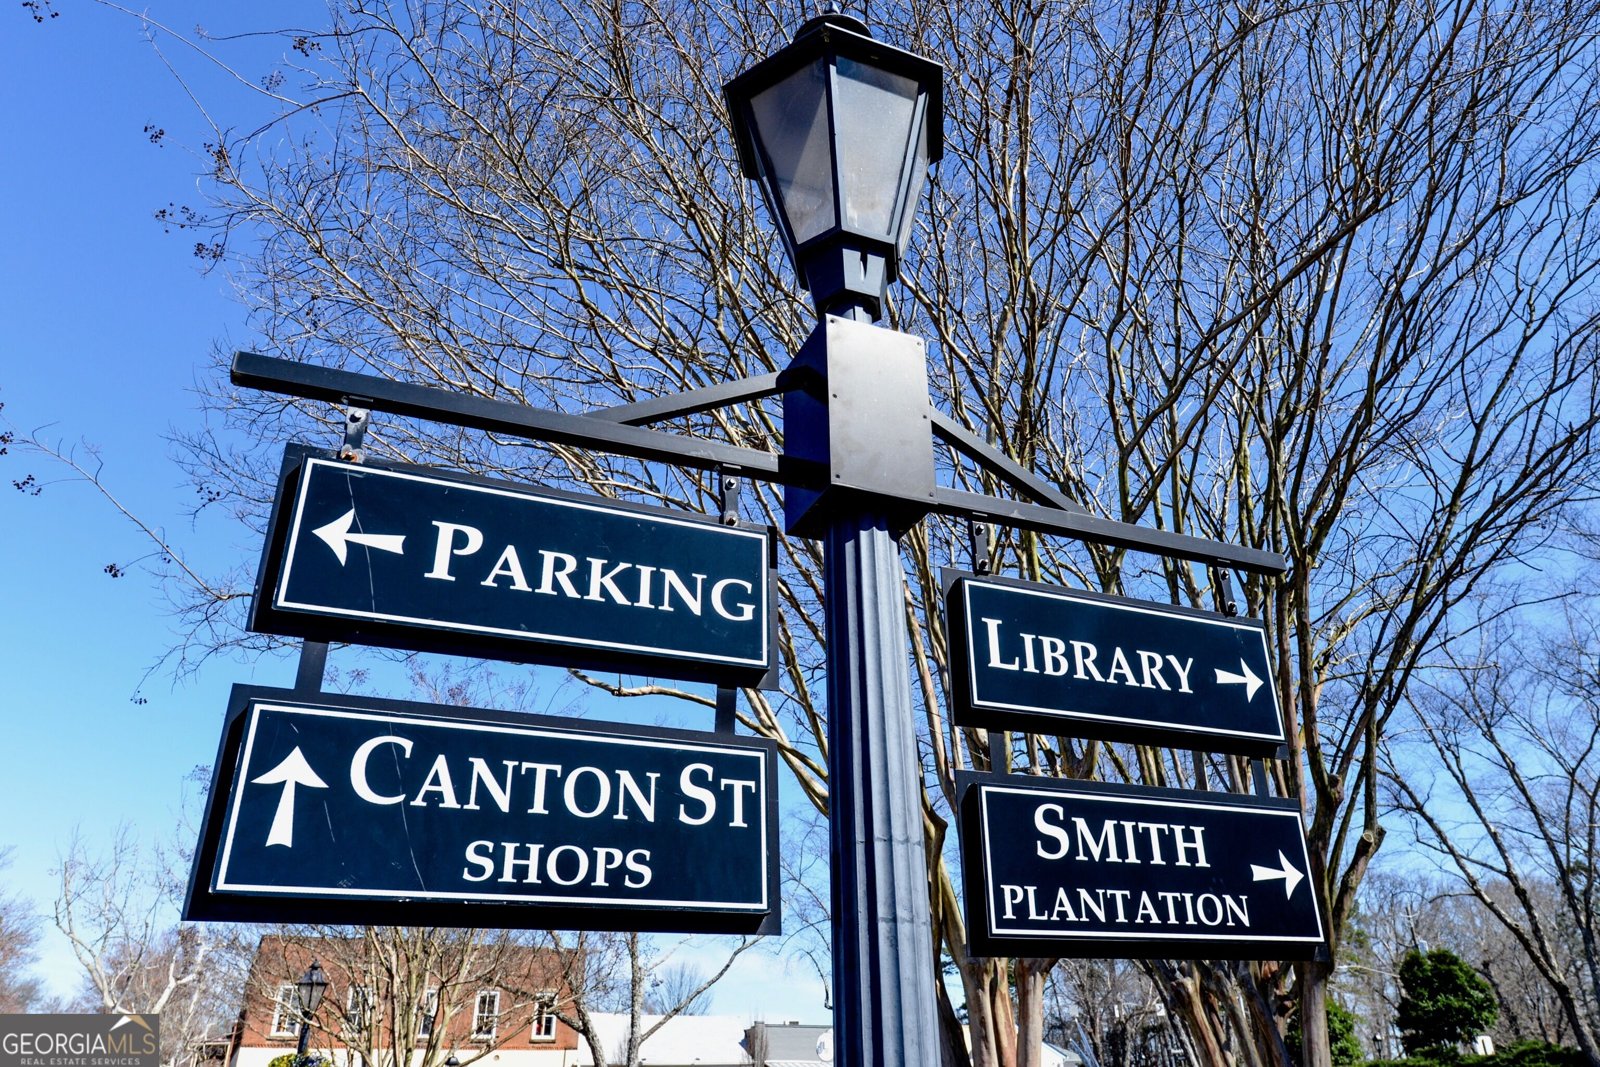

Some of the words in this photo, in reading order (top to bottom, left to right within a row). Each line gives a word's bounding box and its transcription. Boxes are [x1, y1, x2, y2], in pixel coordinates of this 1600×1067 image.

[424, 520, 756, 622] PARKING
[981, 617, 1194, 694] LIBRARY
[350, 735, 661, 823] CANTON
[678, 762, 757, 828] ST
[462, 840, 652, 889] SHOPS
[1034, 803, 1211, 868] SMITH
[1000, 884, 1250, 927] PLANTATION
